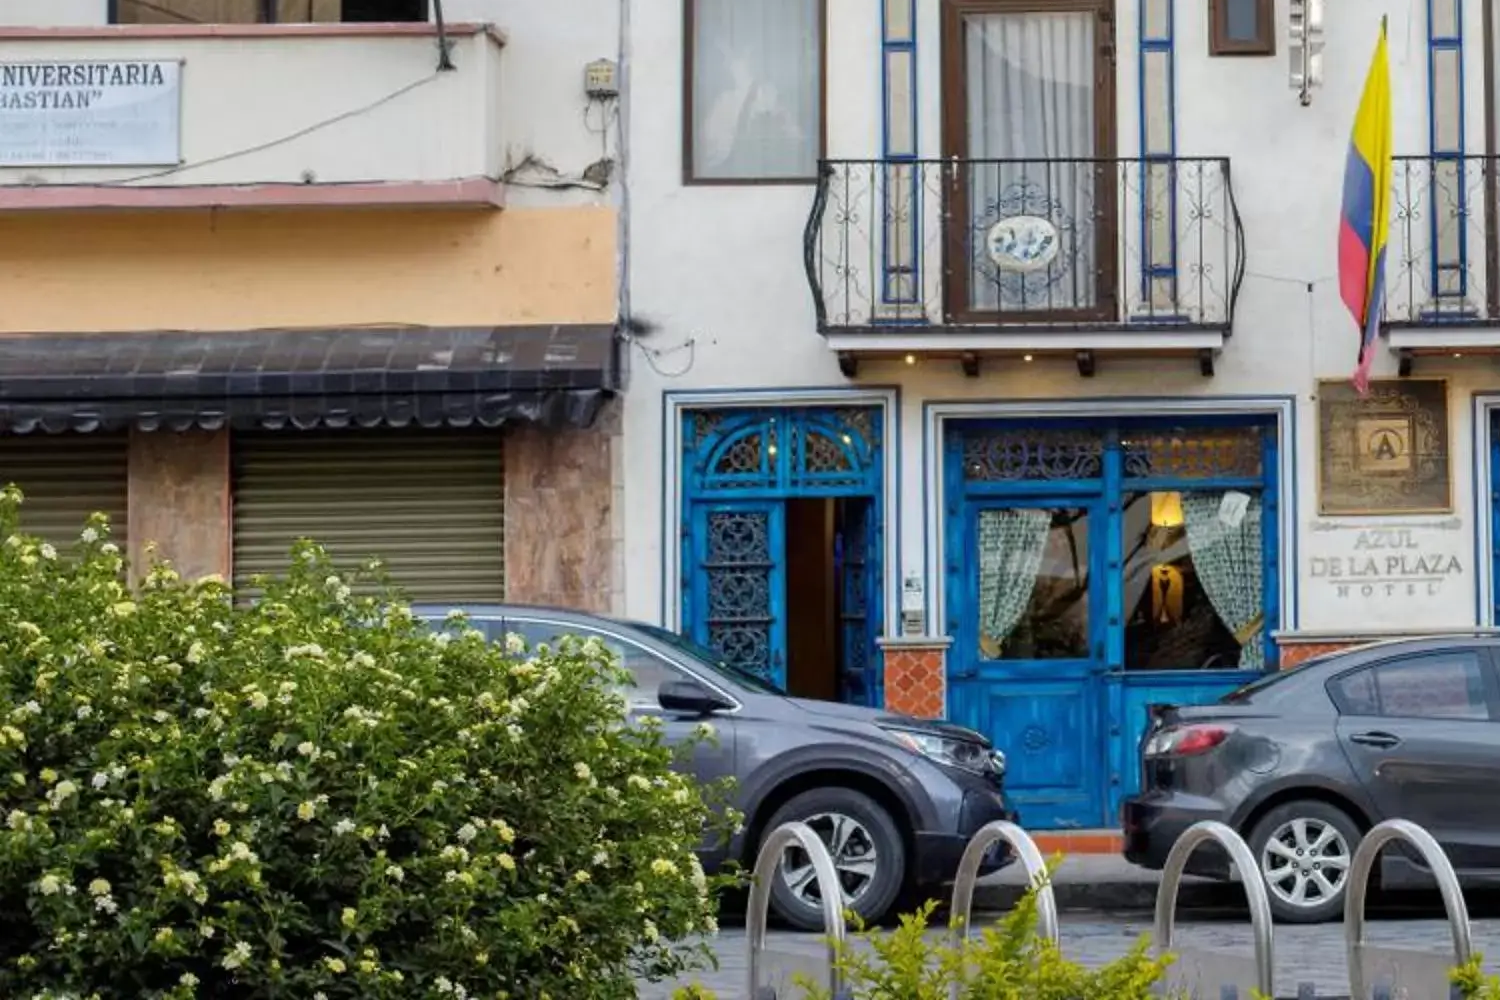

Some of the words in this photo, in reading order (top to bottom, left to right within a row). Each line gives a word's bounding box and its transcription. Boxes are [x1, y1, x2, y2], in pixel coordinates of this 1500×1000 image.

[0, 63, 164, 86] NIVERSITARIA
[1353, 529, 1419, 550] AZUL
[1310, 555, 1343, 578] DE
[1348, 554, 1379, 577] LA
[1385, 552, 1464, 576] PLAZA
[1336, 583, 1438, 598] HOTEL
